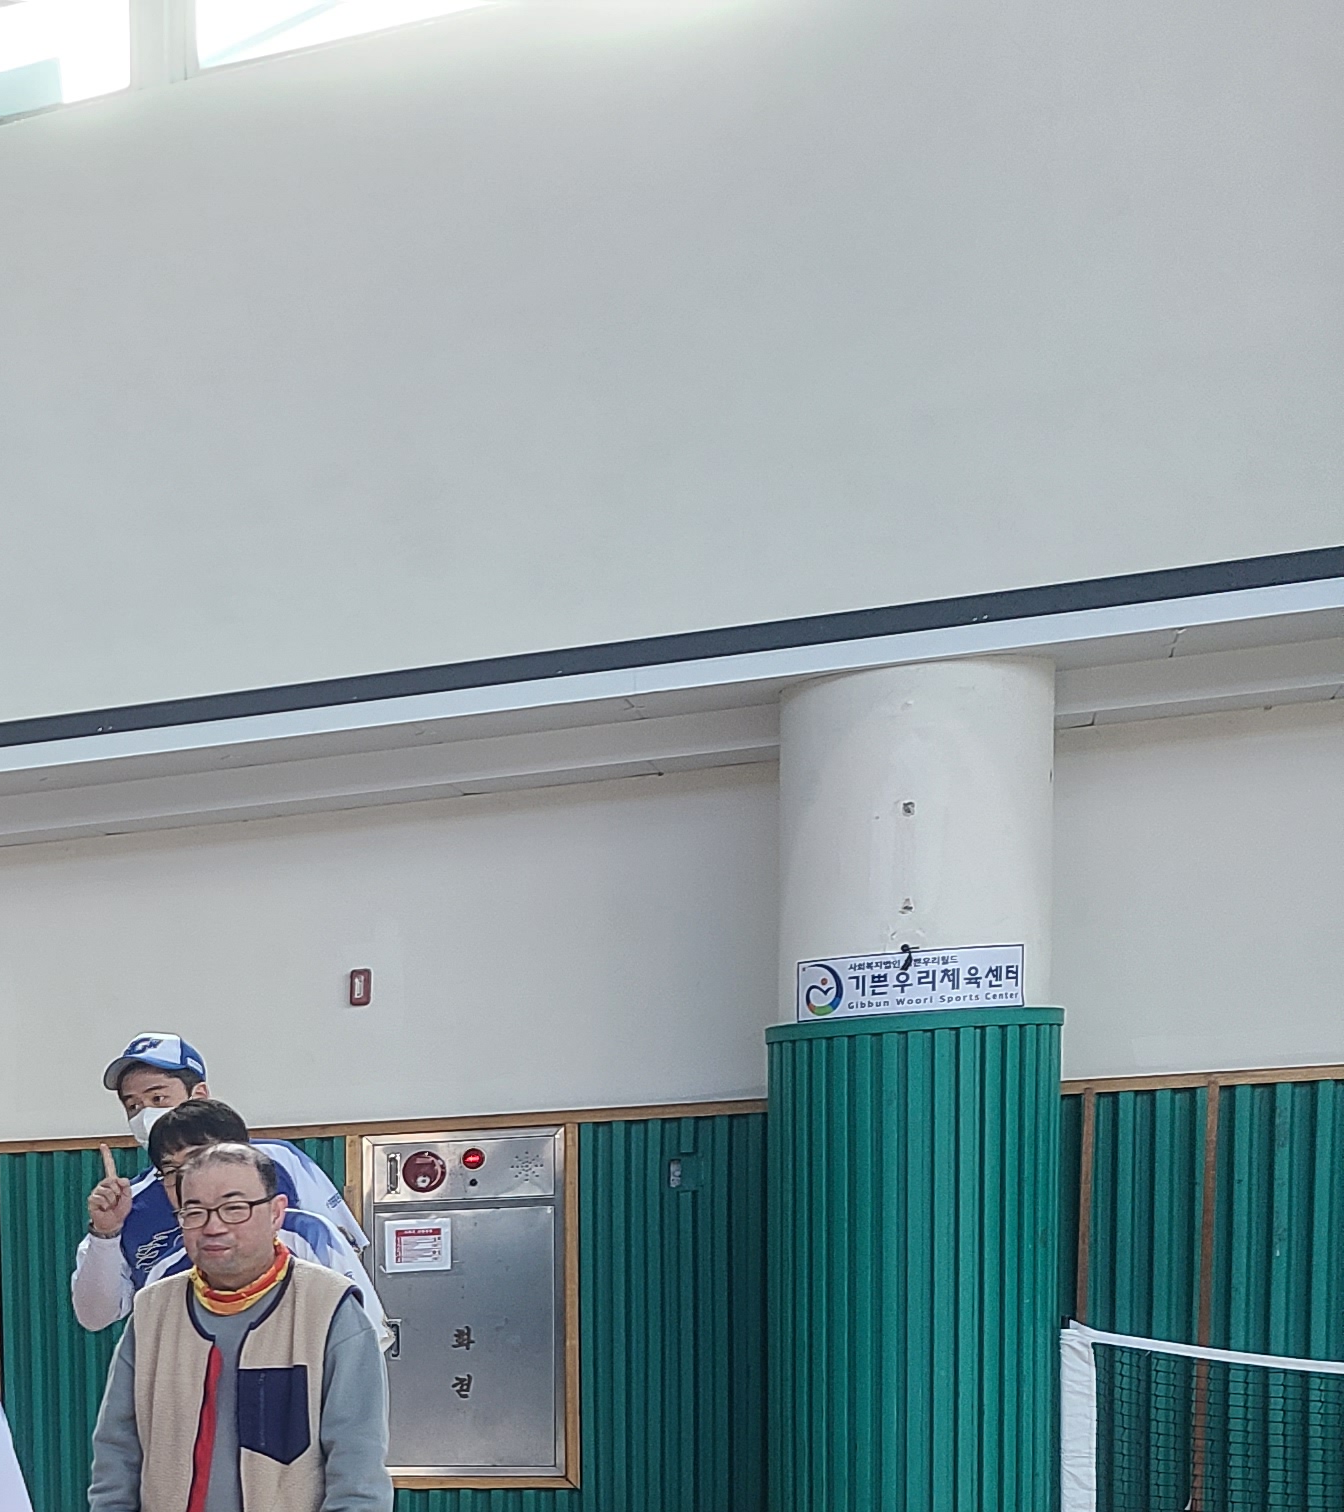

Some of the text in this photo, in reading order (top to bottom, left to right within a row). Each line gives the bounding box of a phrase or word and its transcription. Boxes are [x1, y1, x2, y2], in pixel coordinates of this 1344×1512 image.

[906, 955, 959, 968] 쁜우리월드
[847, 965, 1019, 997] 기쁜우리체육센터
[847, 991, 1019, 1010] Gibbun Woori Sports Center
